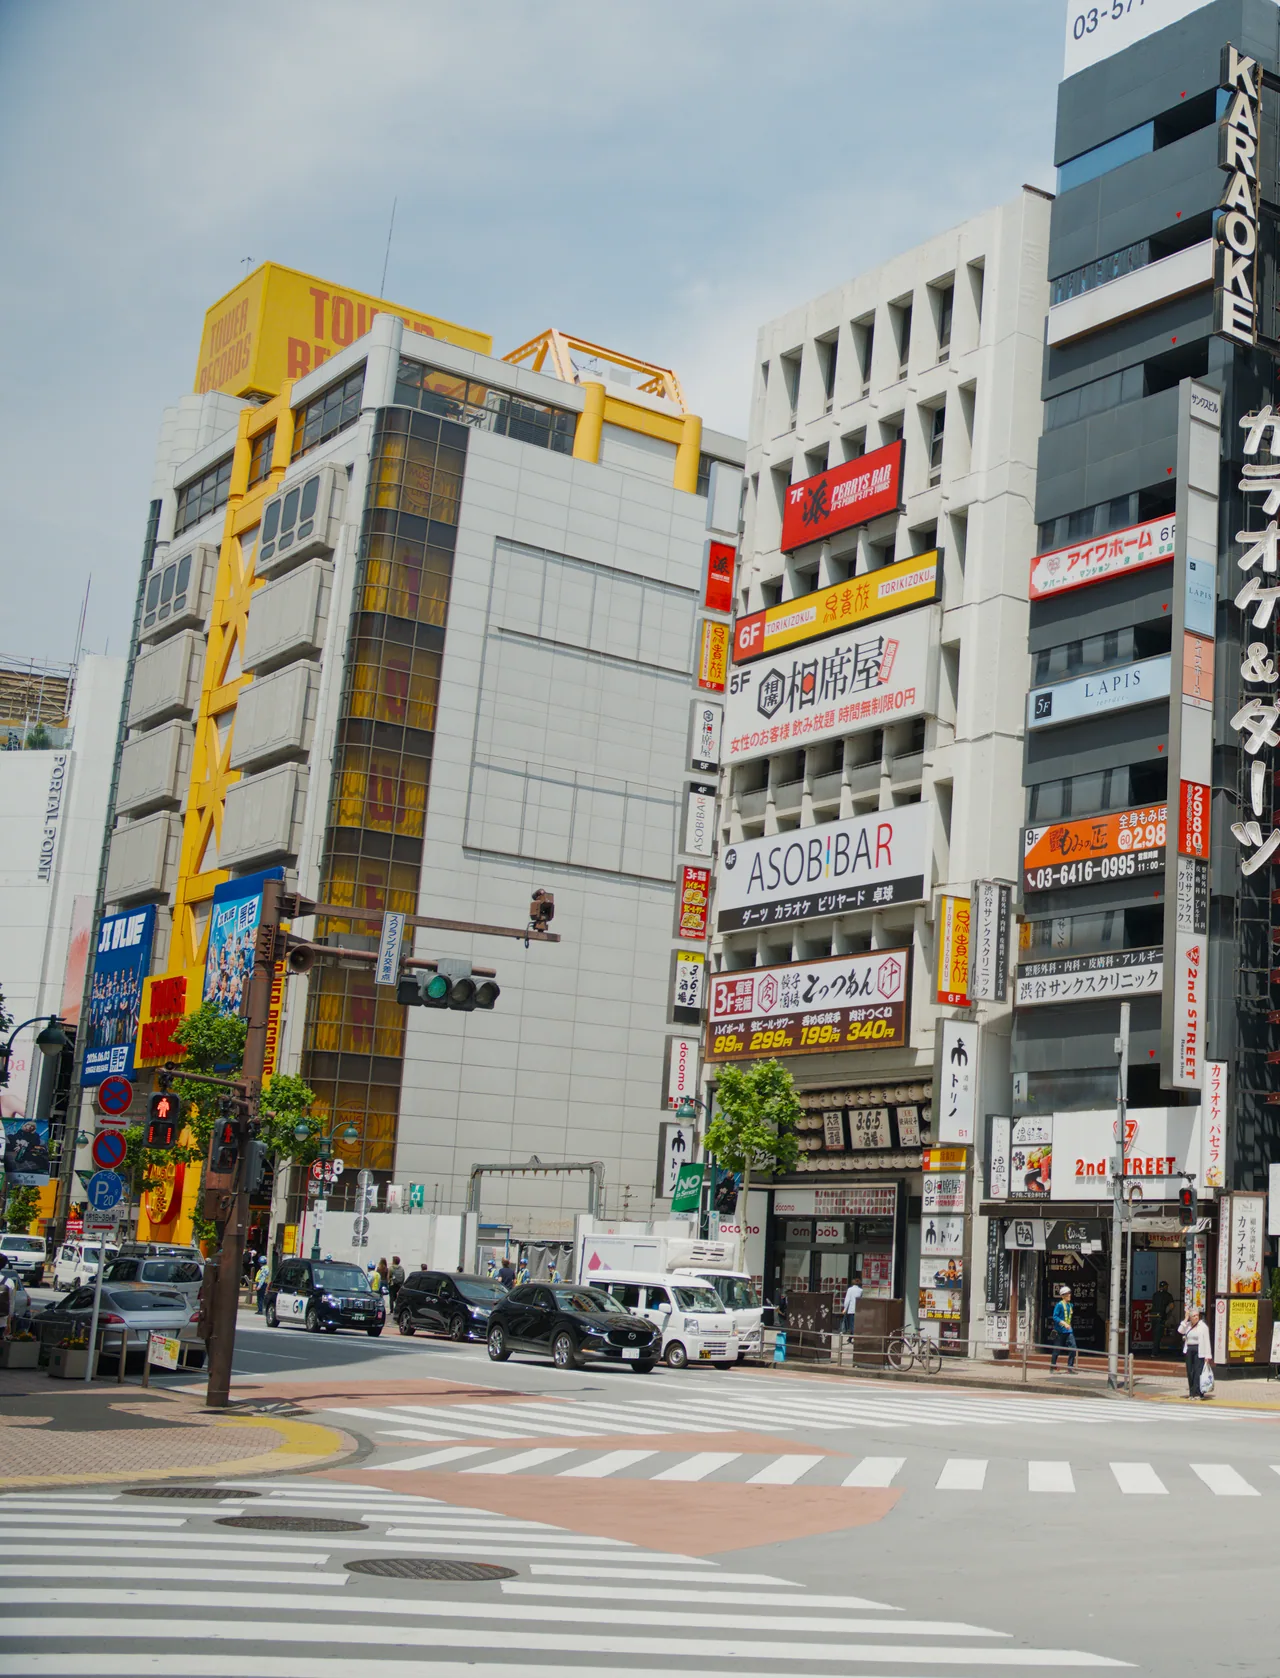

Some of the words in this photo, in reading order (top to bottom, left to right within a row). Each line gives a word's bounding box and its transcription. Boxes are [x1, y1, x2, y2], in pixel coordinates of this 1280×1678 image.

[1223, 46, 1257, 345] KARAOKE
[210, 297, 249, 358] TOWER
[791, 486, 804, 504] 7F
[832, 472, 868, 501] PERRYS
[871, 463, 891, 486] BAR
[1067, 530, 1153, 572] アイワホーム
[880, 569, 931, 596] TORIKIZOKU
[1189, 588, 1212, 601] LAPIS
[739, 622, 761, 649] 6F
[766, 611, 812, 635] TORIKIZOKU
[730, 670, 751, 695] 5F
[786, 636, 884, 713] 相席屋
[1085, 670, 1141, 698] LAPIS
[1036, 698, 1050, 714] 5F
[730, 723, 791, 753] 女性のお客様
[792, 710, 835, 737] 飲み放題
[700, 762, 710, 771] 5F
[45, 754, 67, 824] PORTAL
[697, 785, 708, 794] 4F
[1026, 830, 1040, 846] 9F
[37, 826, 58, 881] POINT
[725, 852, 736, 867] 4F
[747, 822, 893, 894] ASOBIBAR
[686, 868, 697, 880] 3F
[1037, 853, 1135, 889] 03-6416-0995
[1185, 859, 1193, 923] 渋谷サンクス
[742, 907, 768, 926] ダーツ
[775, 901, 811, 920] カラオケ
[818, 891, 865, 913] ビリヤード
[873, 885, 894, 903] 卓球
[379, 914, 402, 982] スクランブル交差点
[944, 906, 952, 981] TORIKIZOKU
[736, 980, 753, 996] 個室
[1020, 969, 1160, 1000] 渋谷サンクスクリニック
[1187, 968, 1197, 1004] 2nd
[715, 984, 735, 1014] 3F
[735, 996, 753, 1012] 完備
[948, 994, 961, 1003] 6F
[715, 1022, 745, 1036] ハイボール
[750, 1030, 792, 1050] 299円
[800, 1024, 840, 1046] 199円
[847, 1019, 895, 1041] 340円
[714, 1035, 743, 1053] 99円
[1186, 1008, 1197, 1080] STREET
[678, 1042, 690, 1092] docomo
[949, 1072, 959, 1118] トリノ
[1210, 1064, 1222, 1120] カラオケ
[1209, 1125, 1221, 1162] パセラ
[1075, 1158, 1105, 1176] 2nd
[1120, 1157, 1176, 1176] TREET
[677, 1174, 700, 1190] NO
[683, 1187, 700, 1198] Smart
[103, 1195, 114, 1206] 20
[775, 1203, 795, 1212] docomo
[924, 1196, 935, 1206] 5F
[1237, 1216, 1247, 1270] カラオケ
[1133, 1309, 1142, 1341] ホーム
